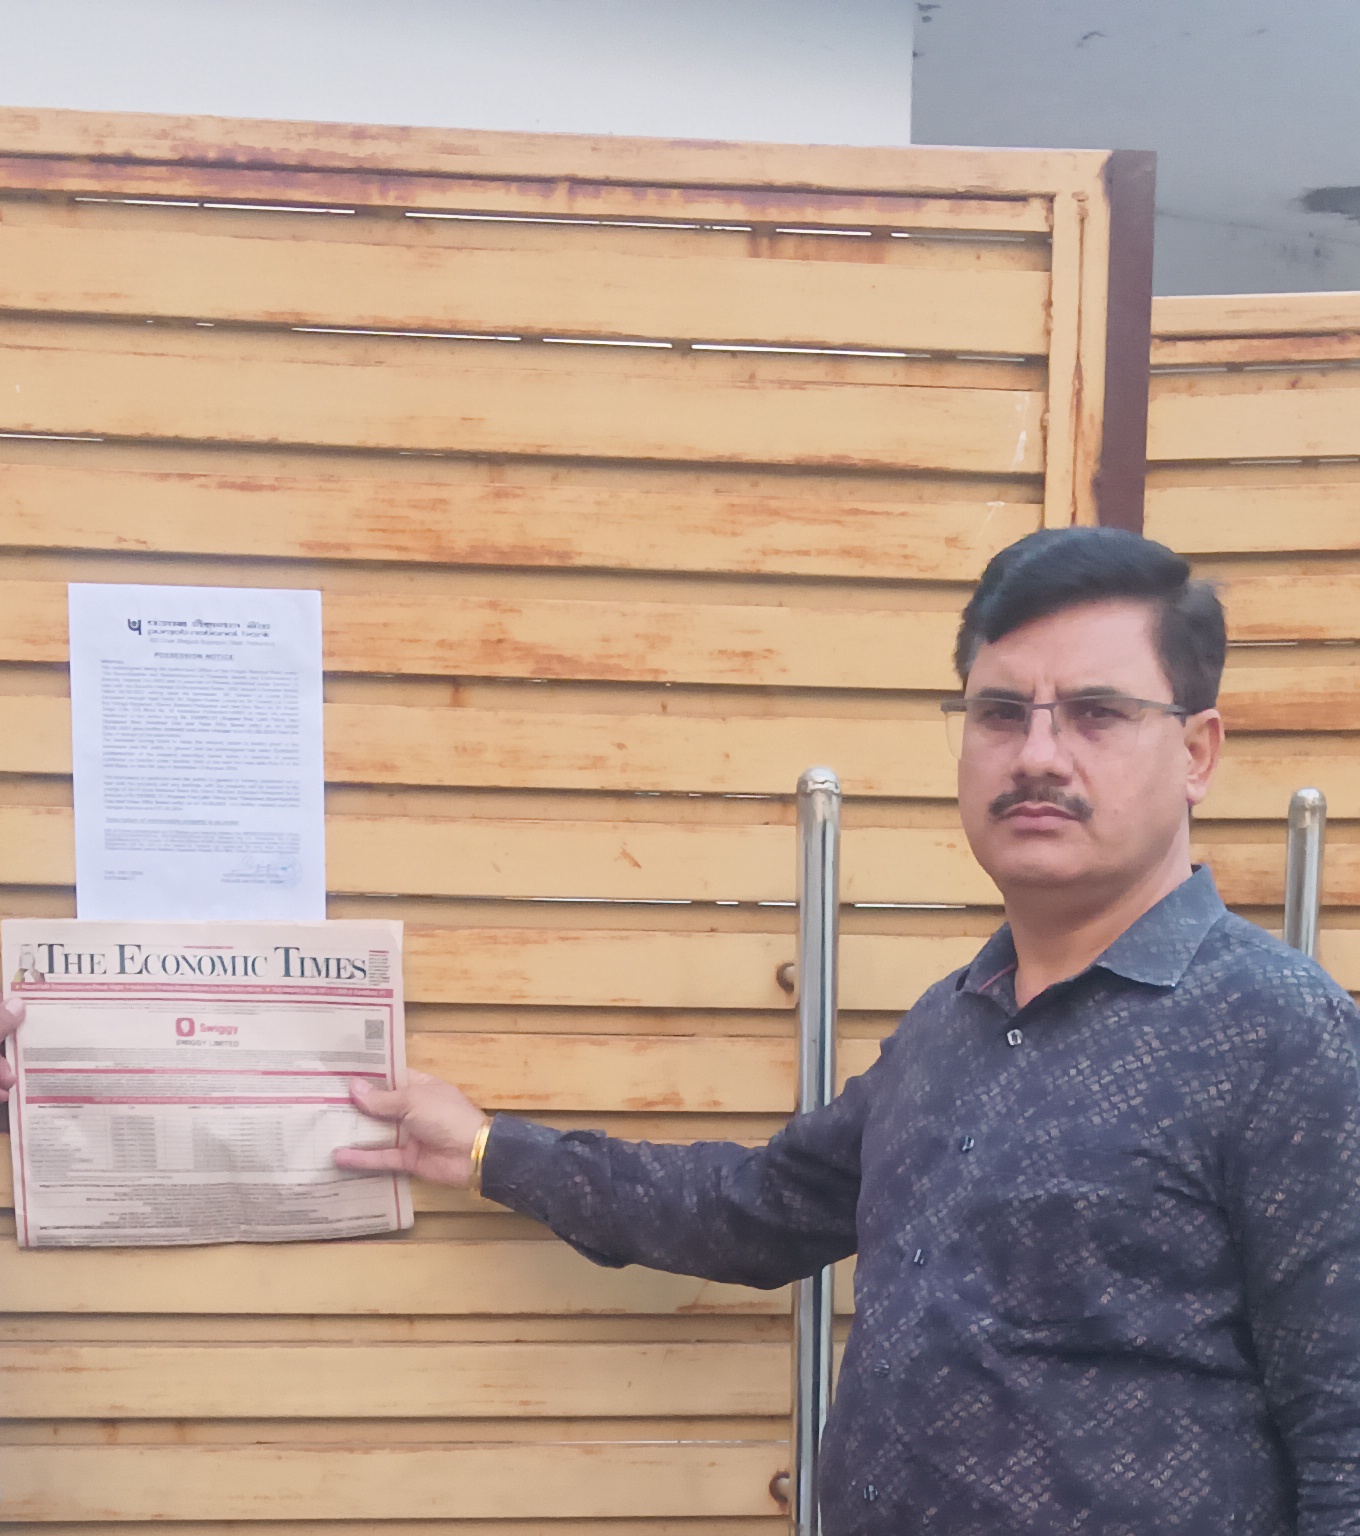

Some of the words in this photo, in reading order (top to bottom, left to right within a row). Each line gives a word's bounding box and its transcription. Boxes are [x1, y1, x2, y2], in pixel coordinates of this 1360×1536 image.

[37, 943, 107, 975] THE
[115, 944, 268, 978] ECONOMIC
[273, 946, 367, 981] TIMES
